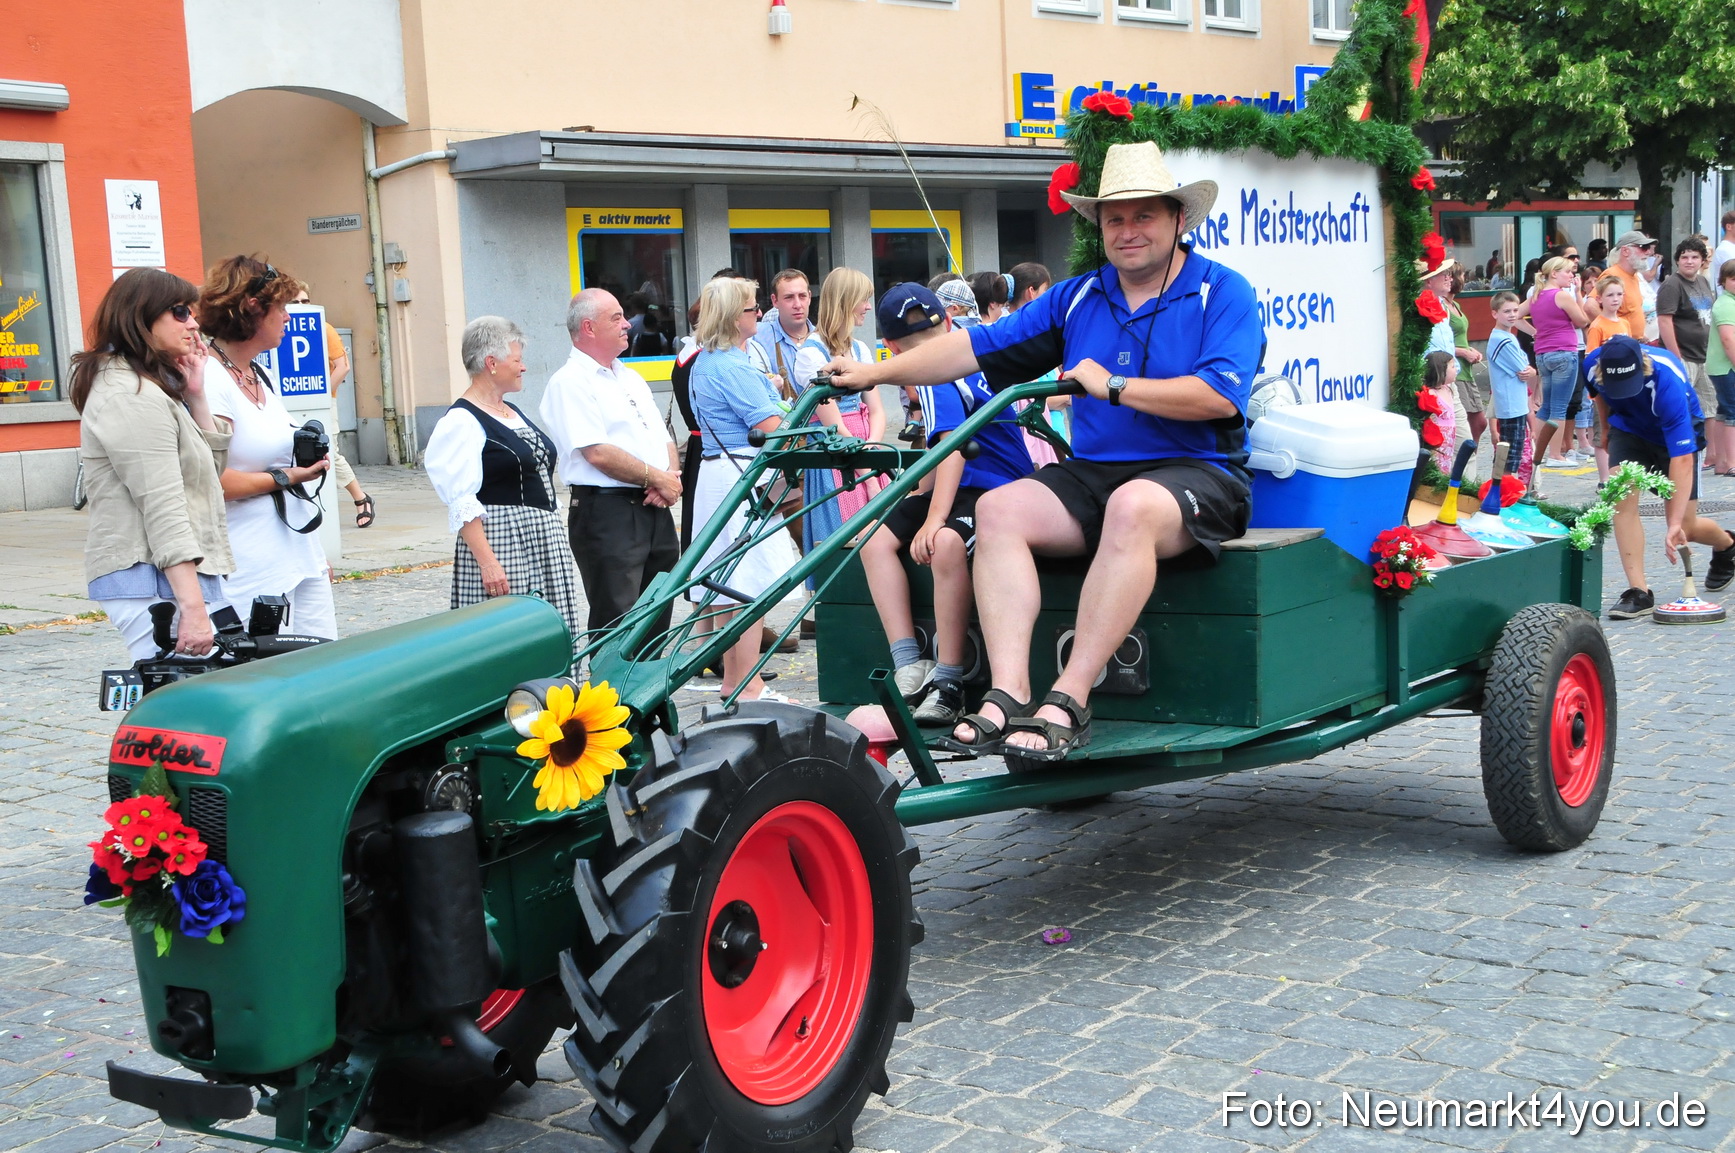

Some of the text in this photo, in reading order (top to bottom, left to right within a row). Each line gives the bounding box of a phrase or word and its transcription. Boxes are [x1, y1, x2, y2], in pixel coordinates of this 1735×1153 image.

[1013, 72, 1055, 120] E
[1021, 126, 1054, 135] EDEKA
[583, 214, 671, 224] E aktiv markt
[1240, 187, 1370, 246] Meisterschaft
[292, 336, 310, 372] P
[282, 375, 324, 392] SCHEINE
[116, 731, 212, 768] Holder
